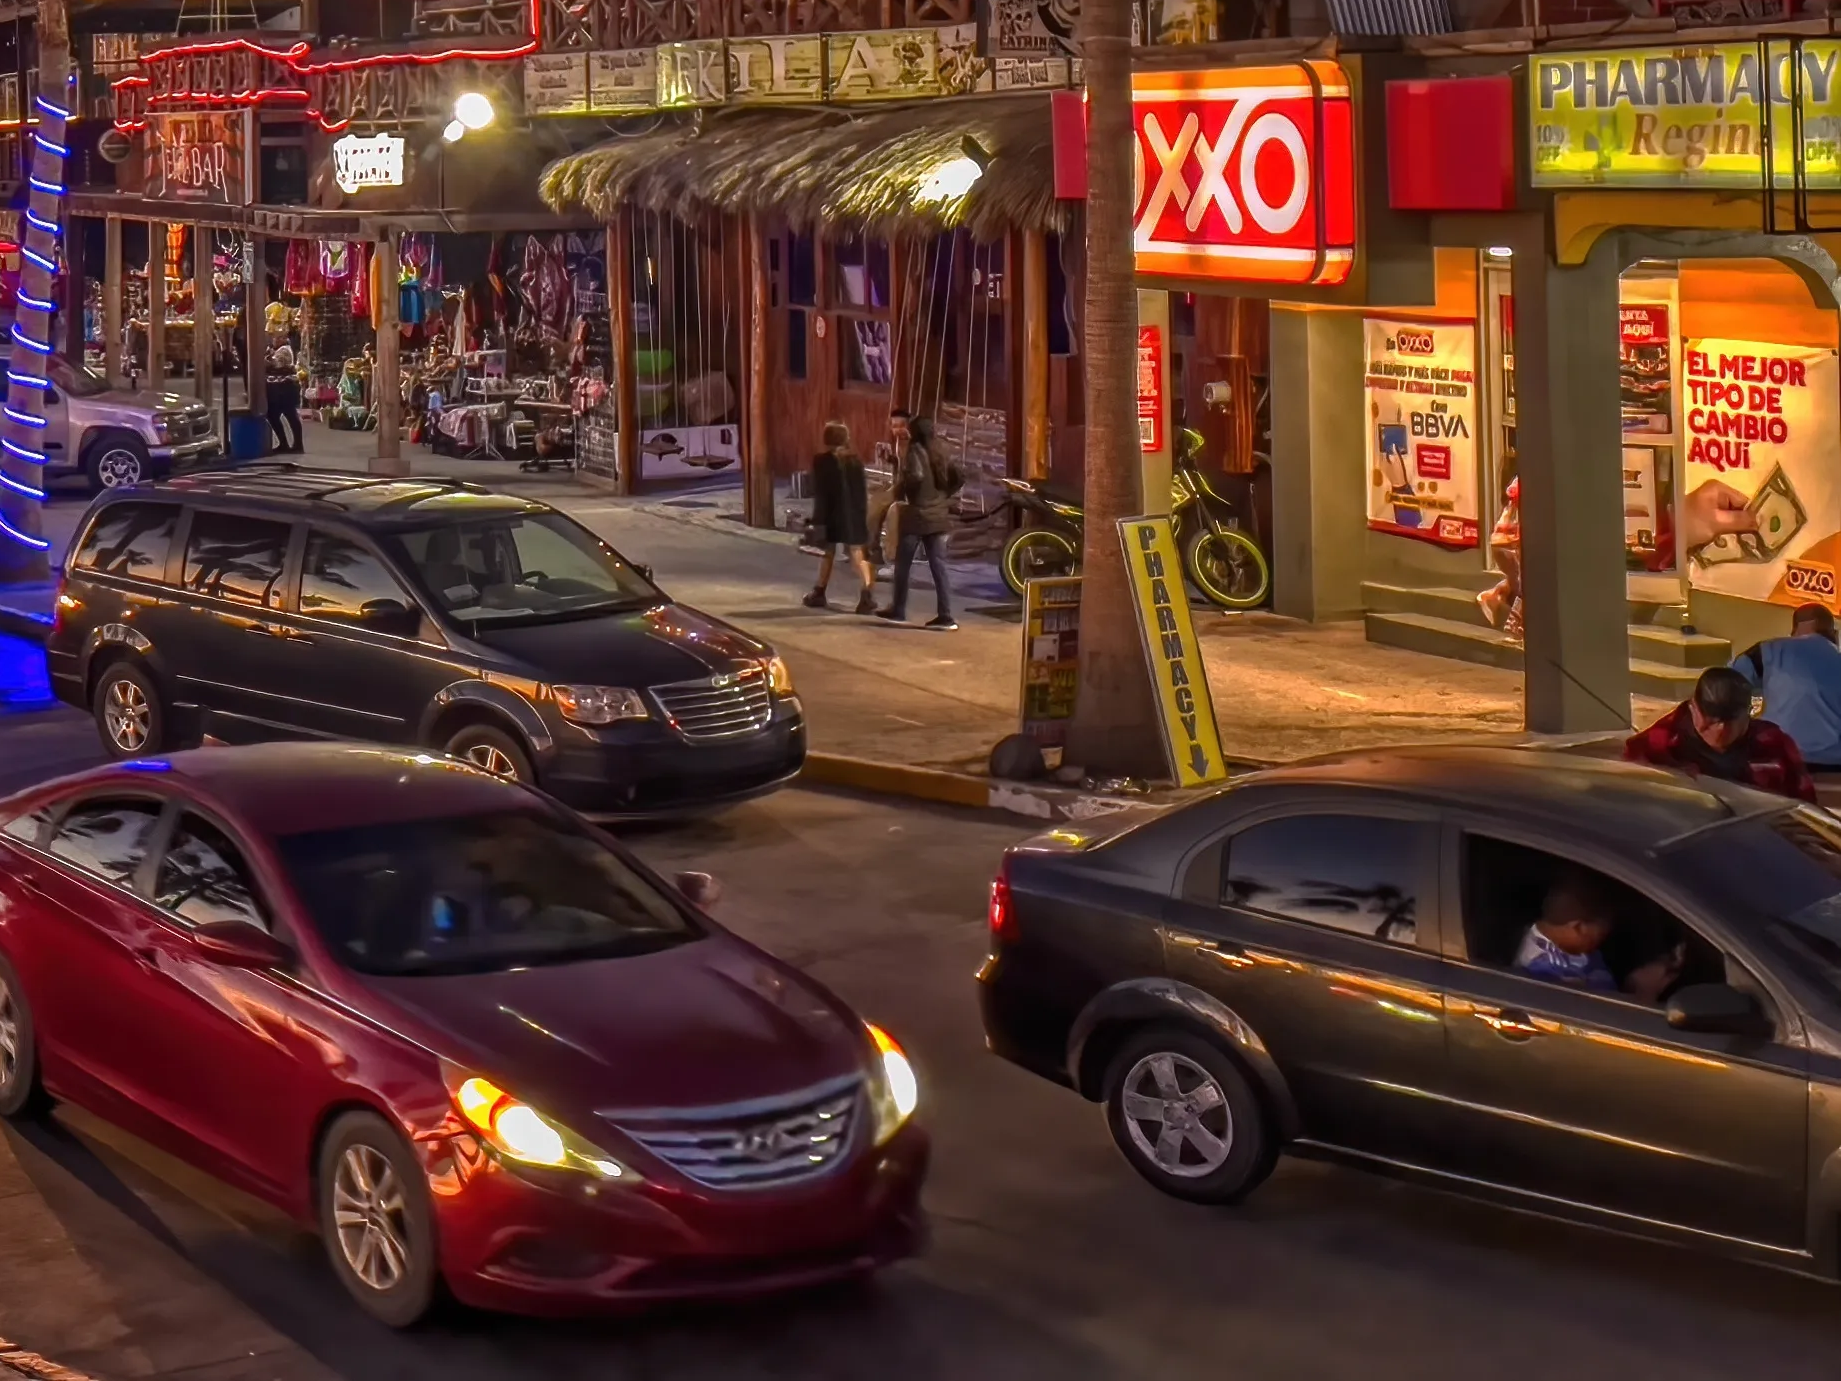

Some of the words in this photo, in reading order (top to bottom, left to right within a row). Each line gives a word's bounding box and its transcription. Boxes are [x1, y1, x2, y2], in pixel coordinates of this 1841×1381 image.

[1538, 50, 1838, 109] PHARMACY
[1629, 109, 1762, 168] Regin
[1134, 98, 1310, 242] XXO
[1687, 351, 1717, 377] EL
[1719, 353, 1807, 387] MEJOR
[1687, 379, 1745, 411] TIPO
[1748, 384, 1783, 414] DE
[1411, 411, 1470, 439] BBVA
[1687, 407, 1789, 444] CAMBIO
[1137, 525, 1196, 742] PHARMACY
